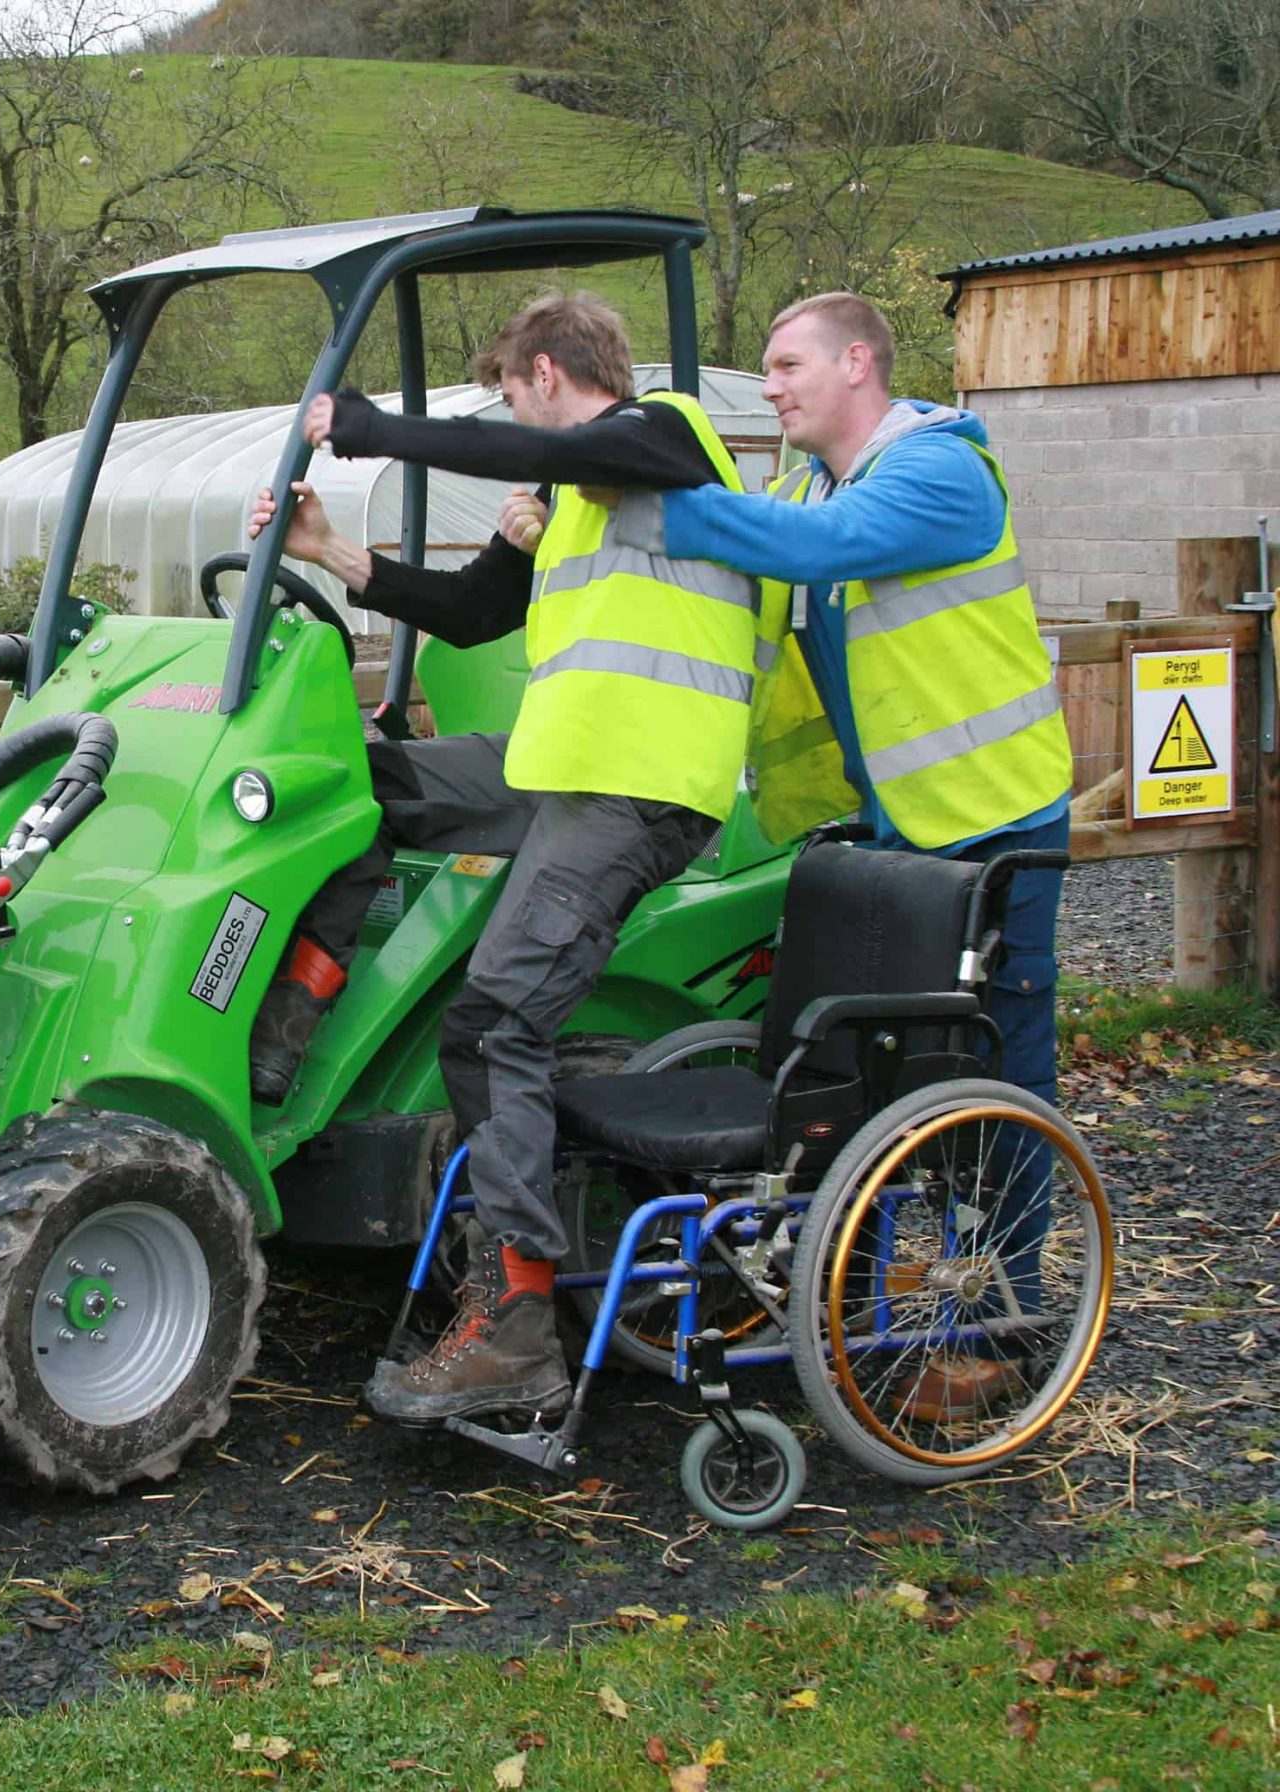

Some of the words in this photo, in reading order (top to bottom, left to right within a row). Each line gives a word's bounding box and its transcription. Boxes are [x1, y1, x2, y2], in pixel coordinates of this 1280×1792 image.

[1166, 660, 1200, 674] Perygl
[1182, 674, 1203, 684] dwfn
[1163, 781, 1202, 794] Danger
[1159, 796, 1181, 806] Deep
[1184, 794, 1207, 804] water
[199, 918, 245, 1002] BEDDOES
[243, 906, 252, 920] LTD
